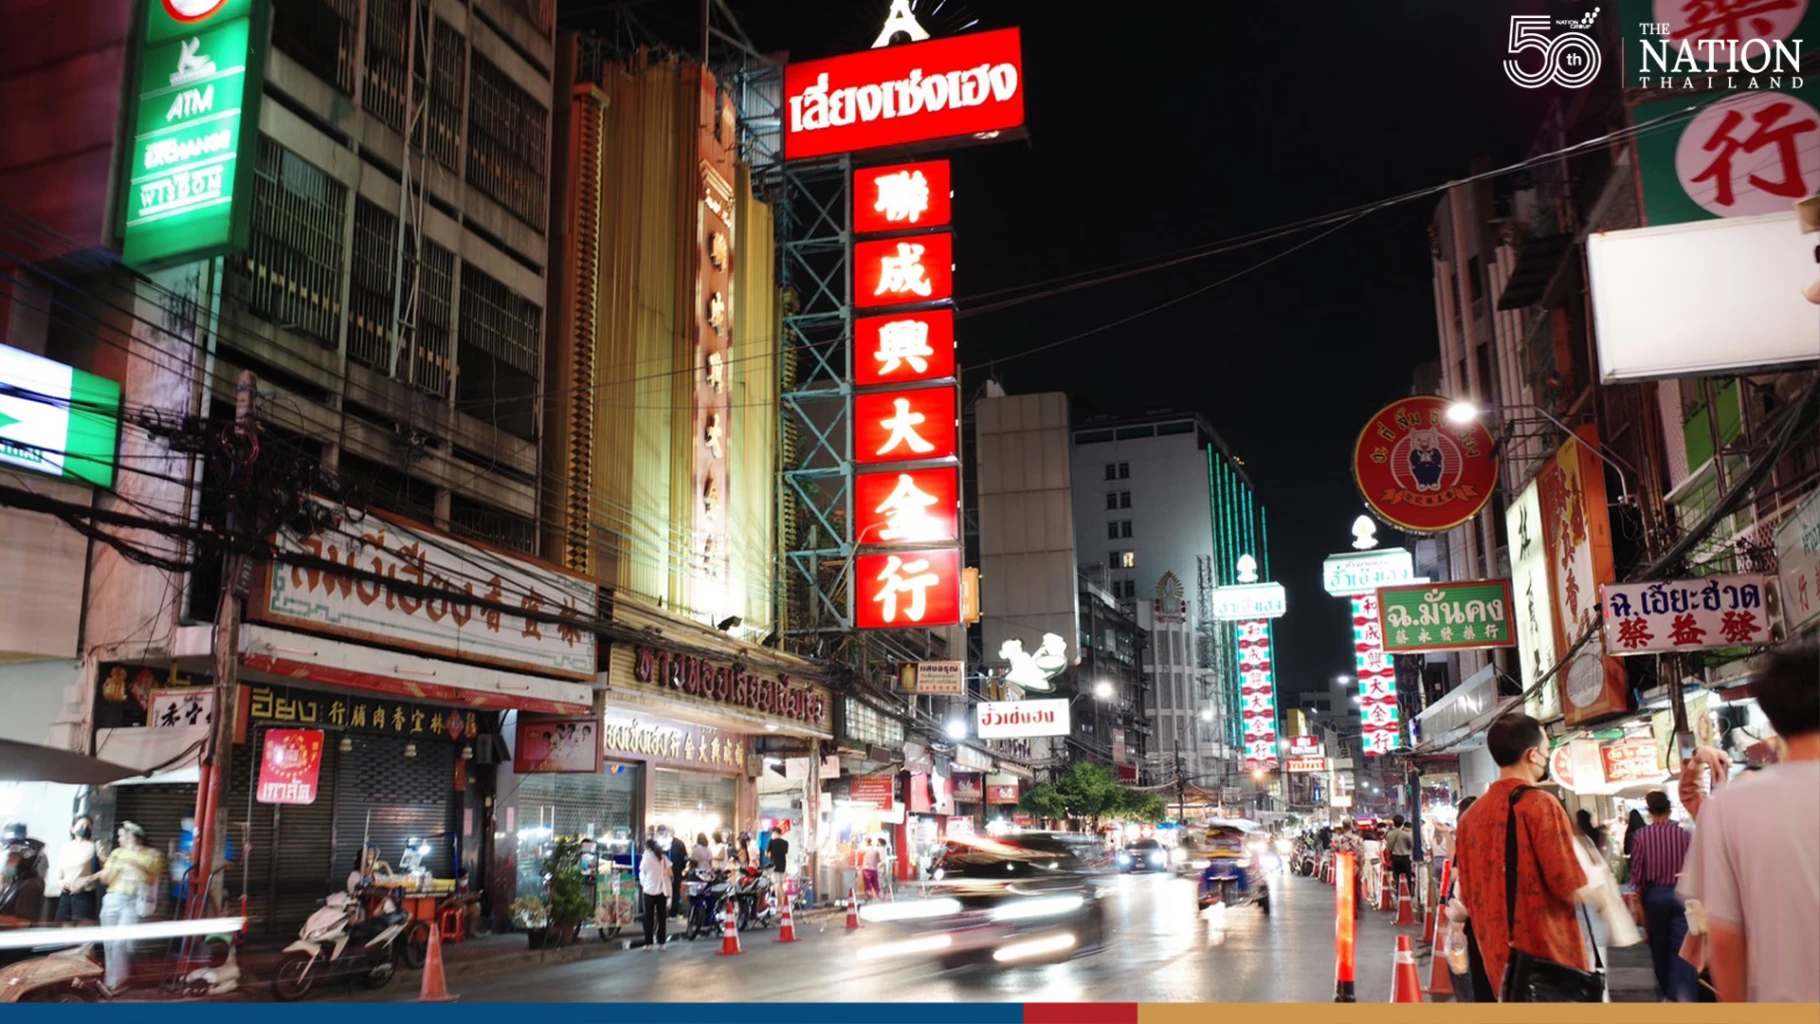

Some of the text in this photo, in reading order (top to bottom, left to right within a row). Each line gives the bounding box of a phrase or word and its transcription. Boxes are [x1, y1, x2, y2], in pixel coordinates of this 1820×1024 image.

[166, 84, 215, 122] ATM
[789, 62, 1018, 133] เลี่ยงเซ่งเฮง
[145, 130, 231, 169] EXCHANGE
[141, 173, 222, 207] WISDOM
[873, 170, 940, 623] 聯成興大金行
[1387, 588, 1504, 627] ฉ.มั่นคง
[1616, 610, 1762, 649] 蔡益發
[920, 665, 958, 674] แสงอรุณ
[262, 777, 311, 801] เกาลัด
